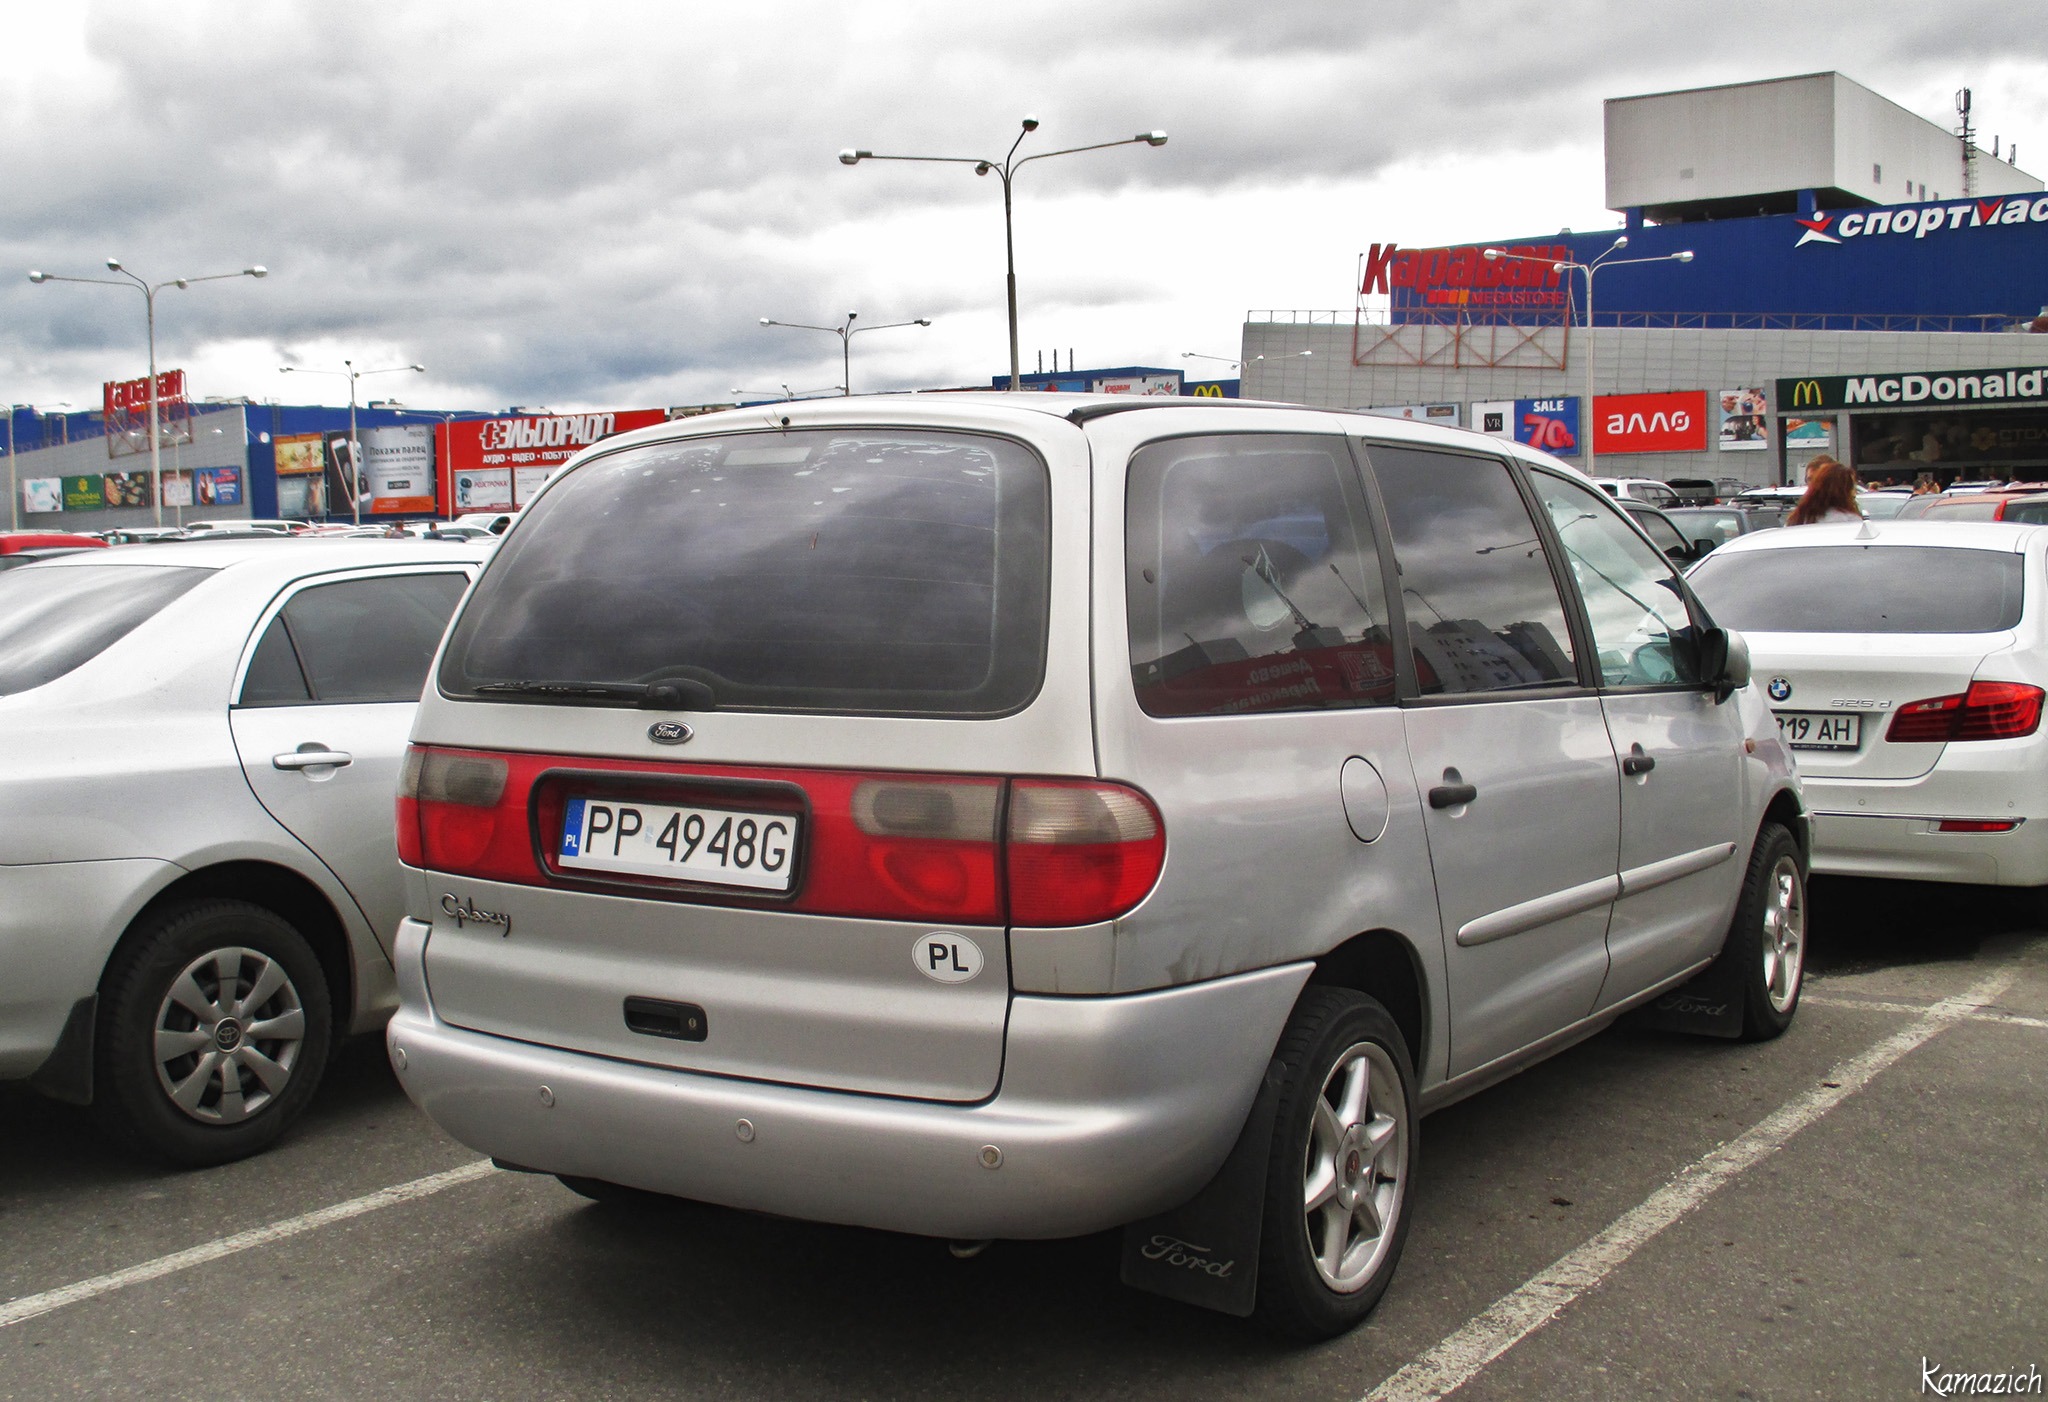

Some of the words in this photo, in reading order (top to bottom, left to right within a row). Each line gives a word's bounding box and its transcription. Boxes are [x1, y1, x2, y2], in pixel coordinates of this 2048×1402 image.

[1360, 243, 1568, 294] Караван
[1471, 291, 1565, 304] MEGASTORE
[1844, 371, 2048, 403] McDonald'
[1533, 400, 1564, 412] SALE
[655, 724, 681, 737] Ford
[1817, 719, 1850, 741] AH
[565, 833, 578, 848] PL
[585, 805, 643, 856] PP
[656, 812, 788, 872] 4948G
[928, 943, 969, 972] PL
[1658, 994, 1727, 1016] Ford
[1141, 1235, 1234, 1277] Ford
